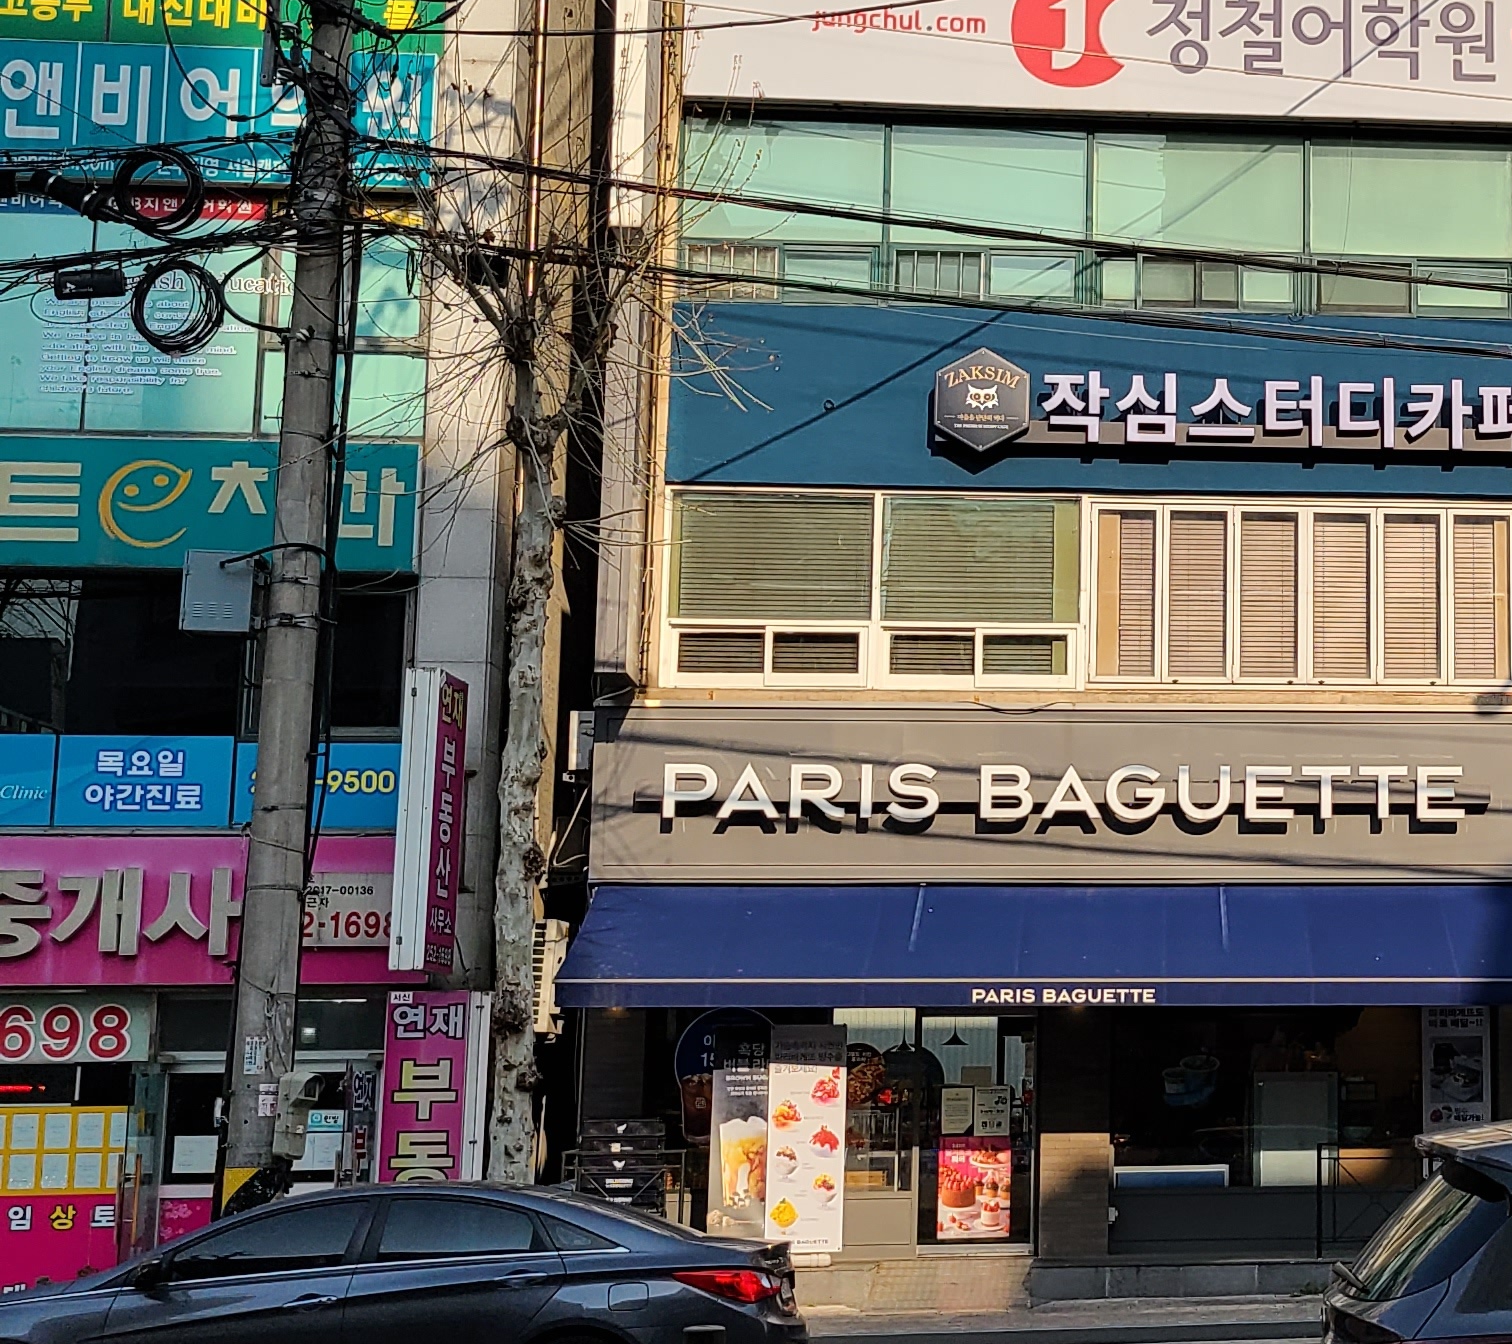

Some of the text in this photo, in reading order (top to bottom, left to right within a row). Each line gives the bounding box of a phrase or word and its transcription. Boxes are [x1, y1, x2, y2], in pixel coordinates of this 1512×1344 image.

[810, 7, 988, 35] jungchul.com
[944, 364, 1021, 389] ZAKSIM
[97, 750, 184, 778] 목요일
[1, 785, 48, 800] Clinic
[84, 784, 203, 813] 야간진료
[661, 761, 1466, 824] PARIS BAGUETTE
[436, 736, 458, 900] 부동산
[971, 988, 1156, 1004] PARIS BAGUETTE
[392, 1004, 465, 1039] 연재
